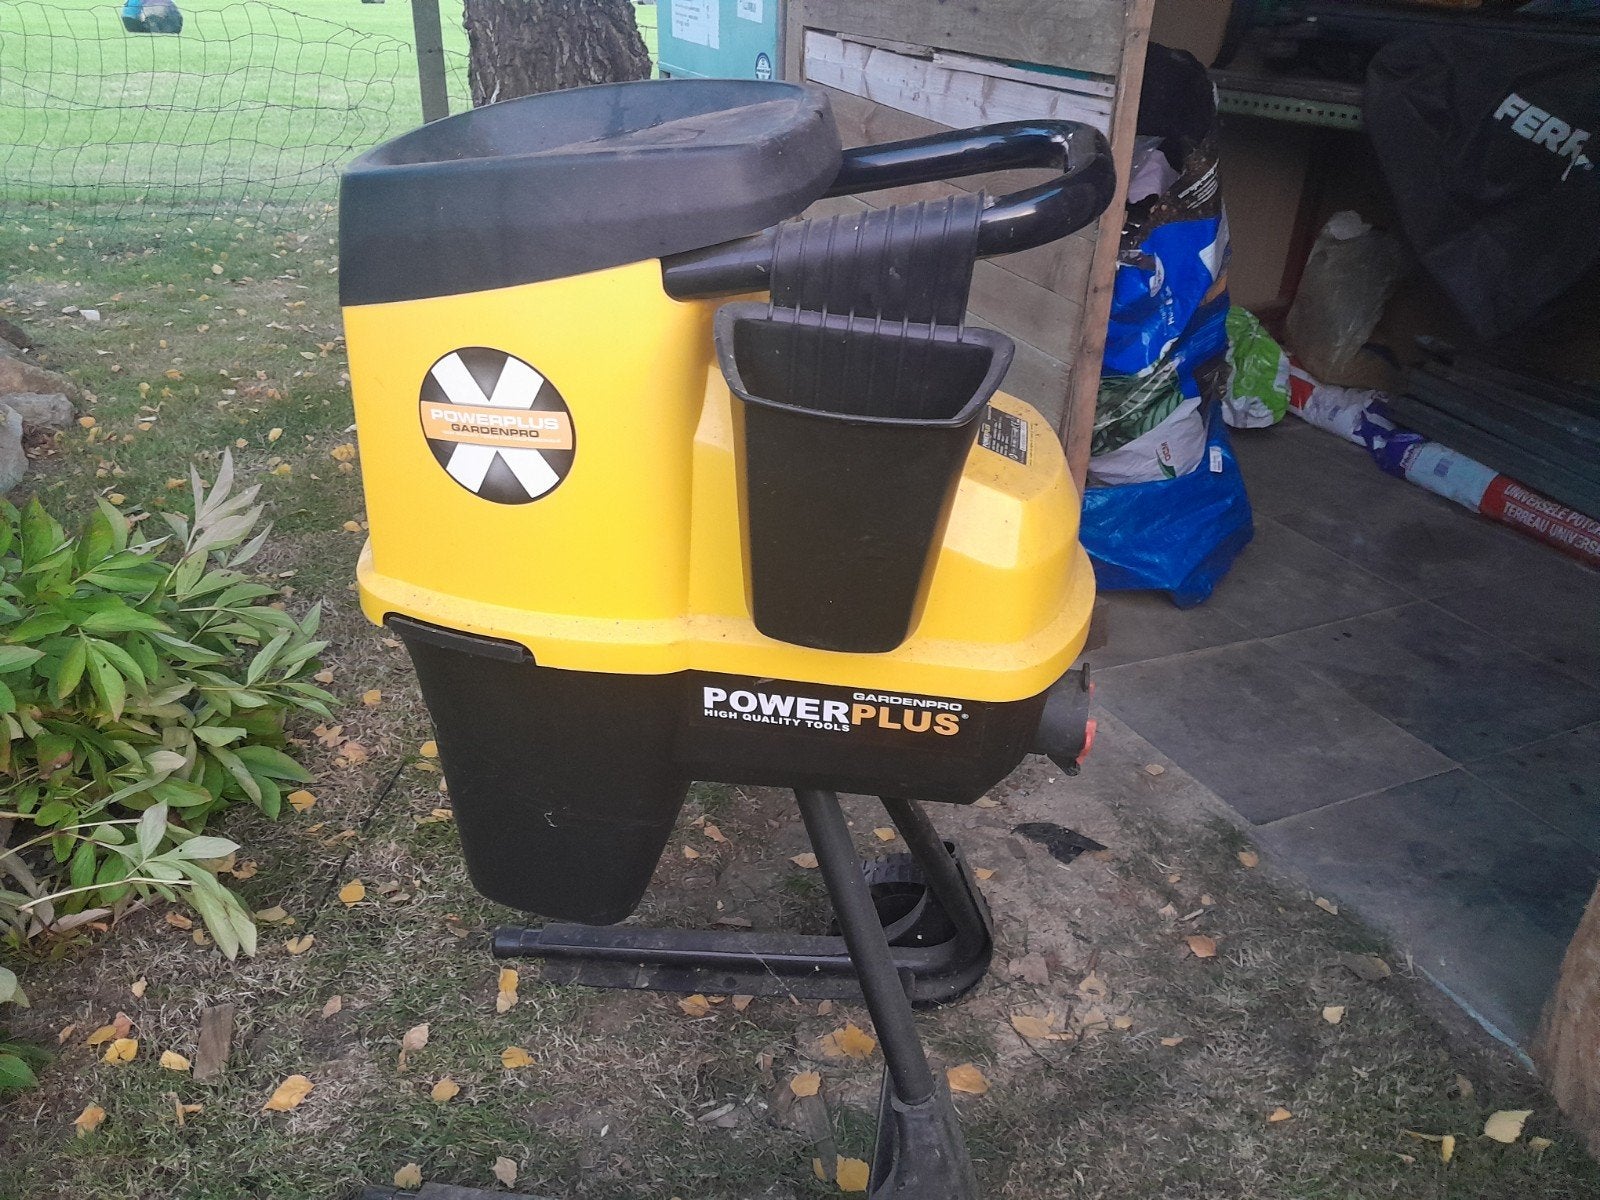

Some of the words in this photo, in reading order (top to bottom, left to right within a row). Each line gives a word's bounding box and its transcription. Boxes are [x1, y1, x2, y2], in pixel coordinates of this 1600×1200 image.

[430, 408, 560, 430] POWERPLUS
[451, 423, 540, 438] GARDENPRO
[1503, 501, 1550, 533] TERREAU
[852, 692, 963, 711] GARDENPRO
[703, 708, 738, 720] HIGH
[742, 713, 801, 727] QUALITY
[805, 720, 850, 732] TOOLS
